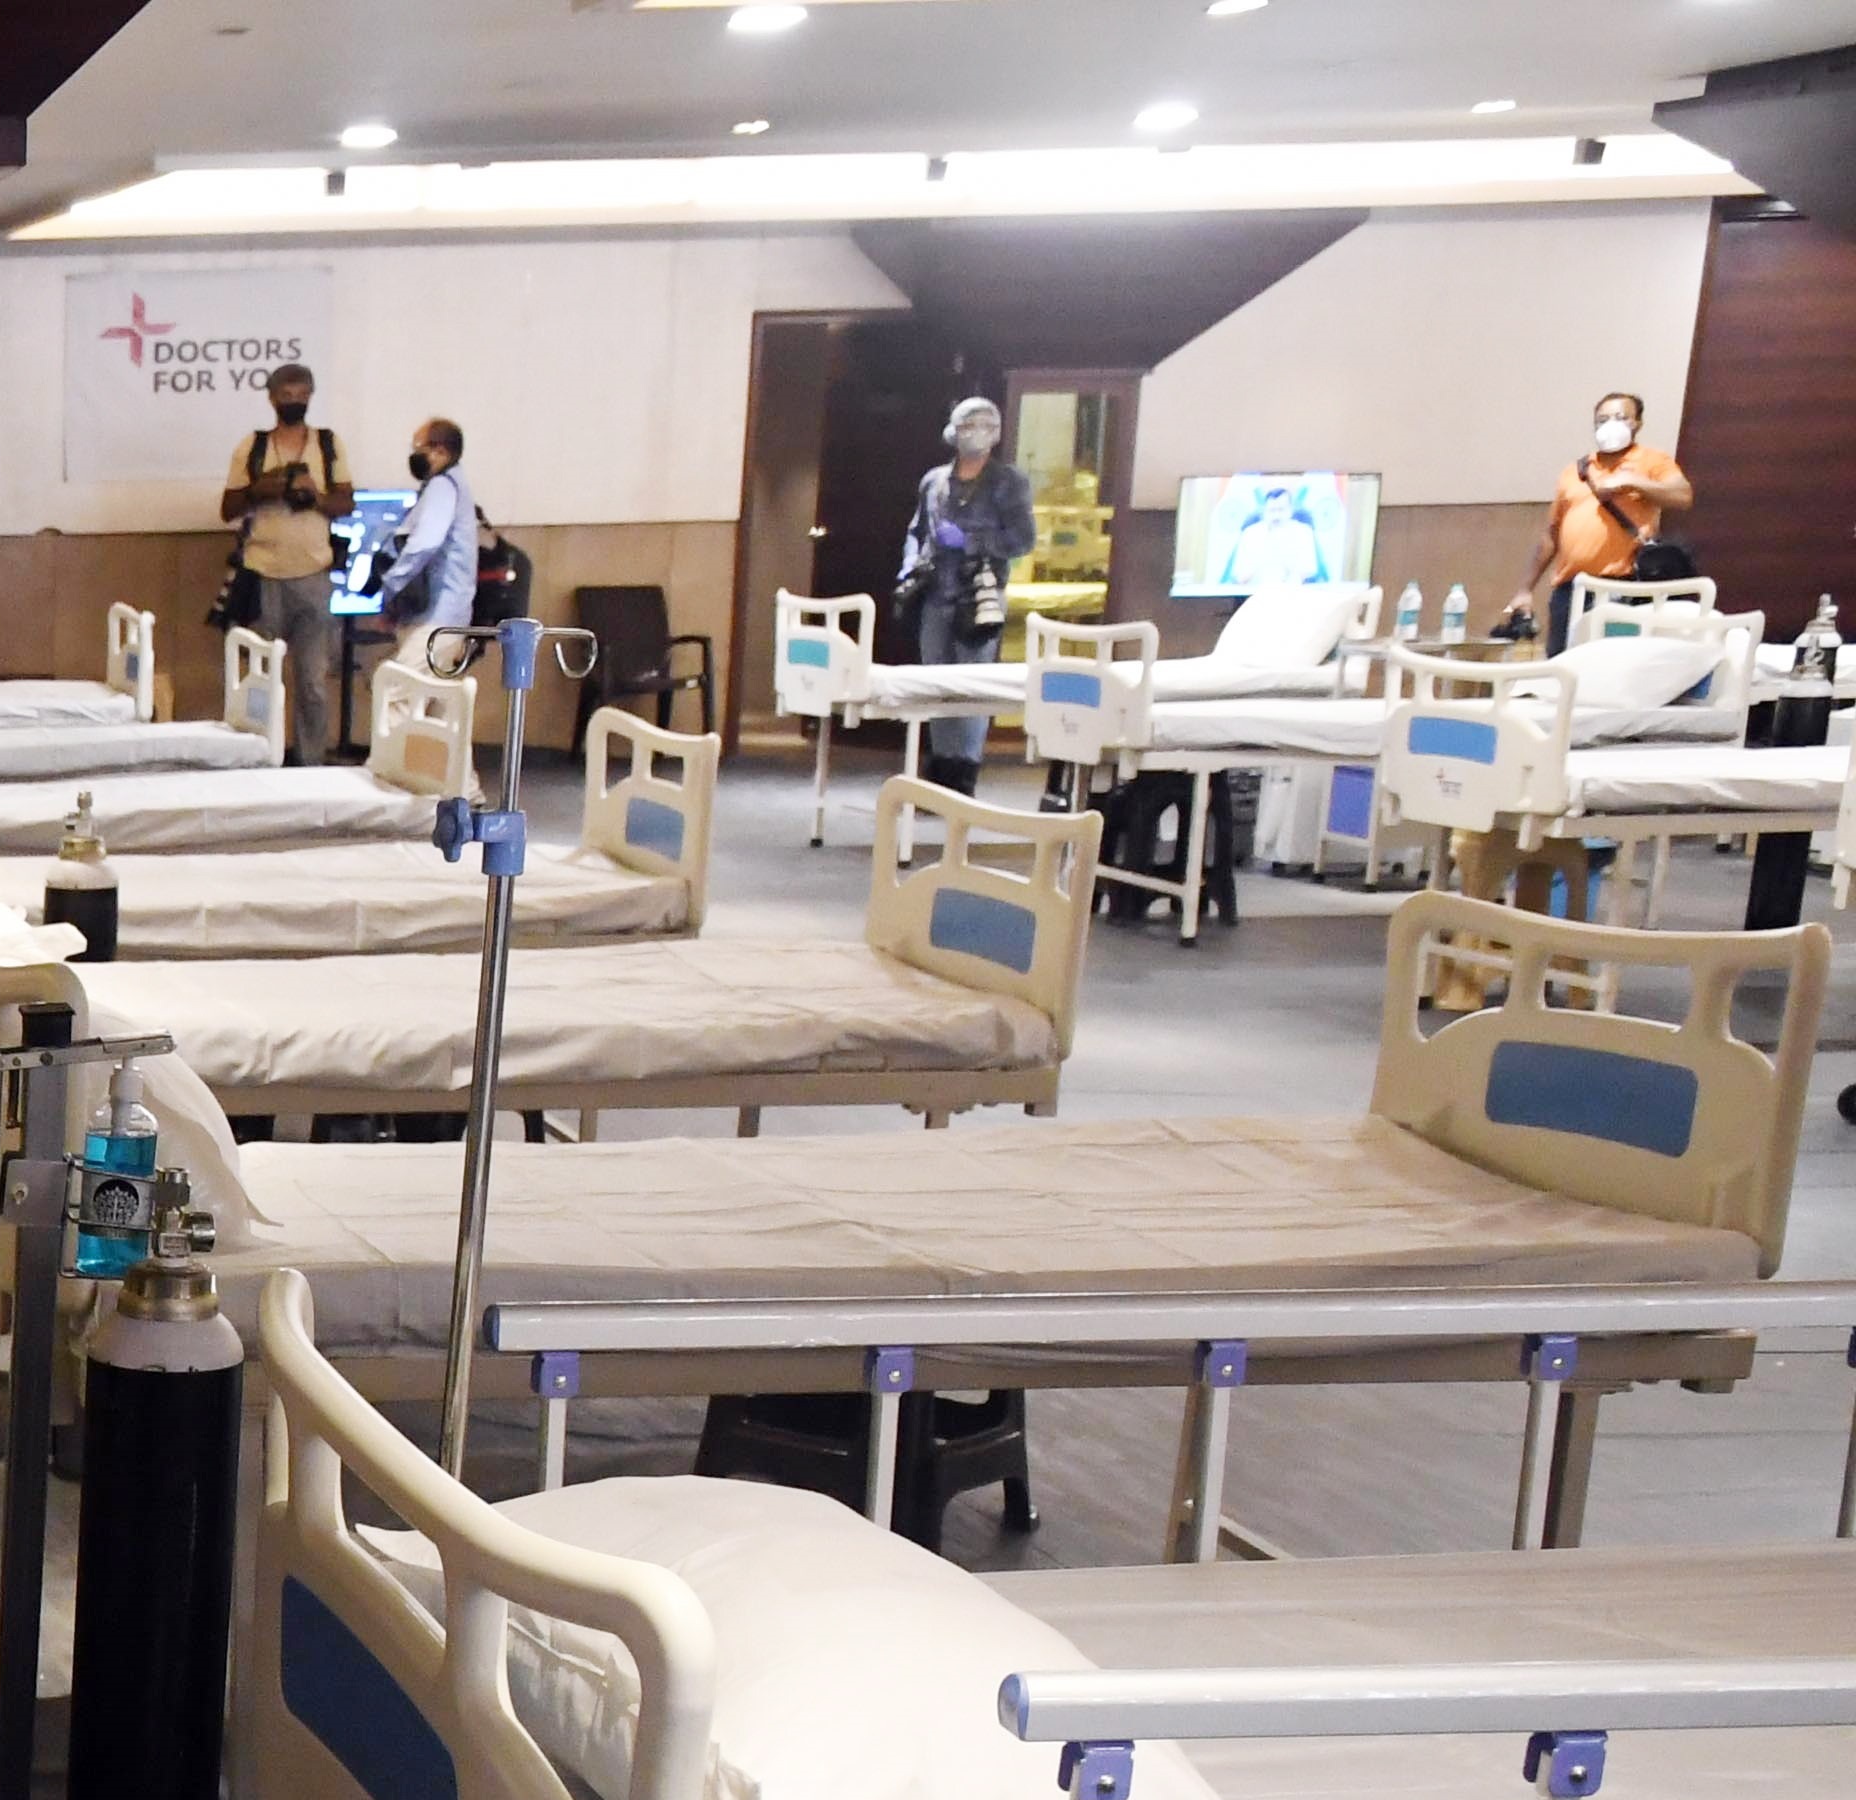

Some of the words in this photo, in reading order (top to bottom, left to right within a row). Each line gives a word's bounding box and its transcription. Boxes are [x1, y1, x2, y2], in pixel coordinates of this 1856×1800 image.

[153, 337, 302, 364] DOCTORS
[153, 369, 216, 393] FOR
[229, 367, 272, 392] YO
